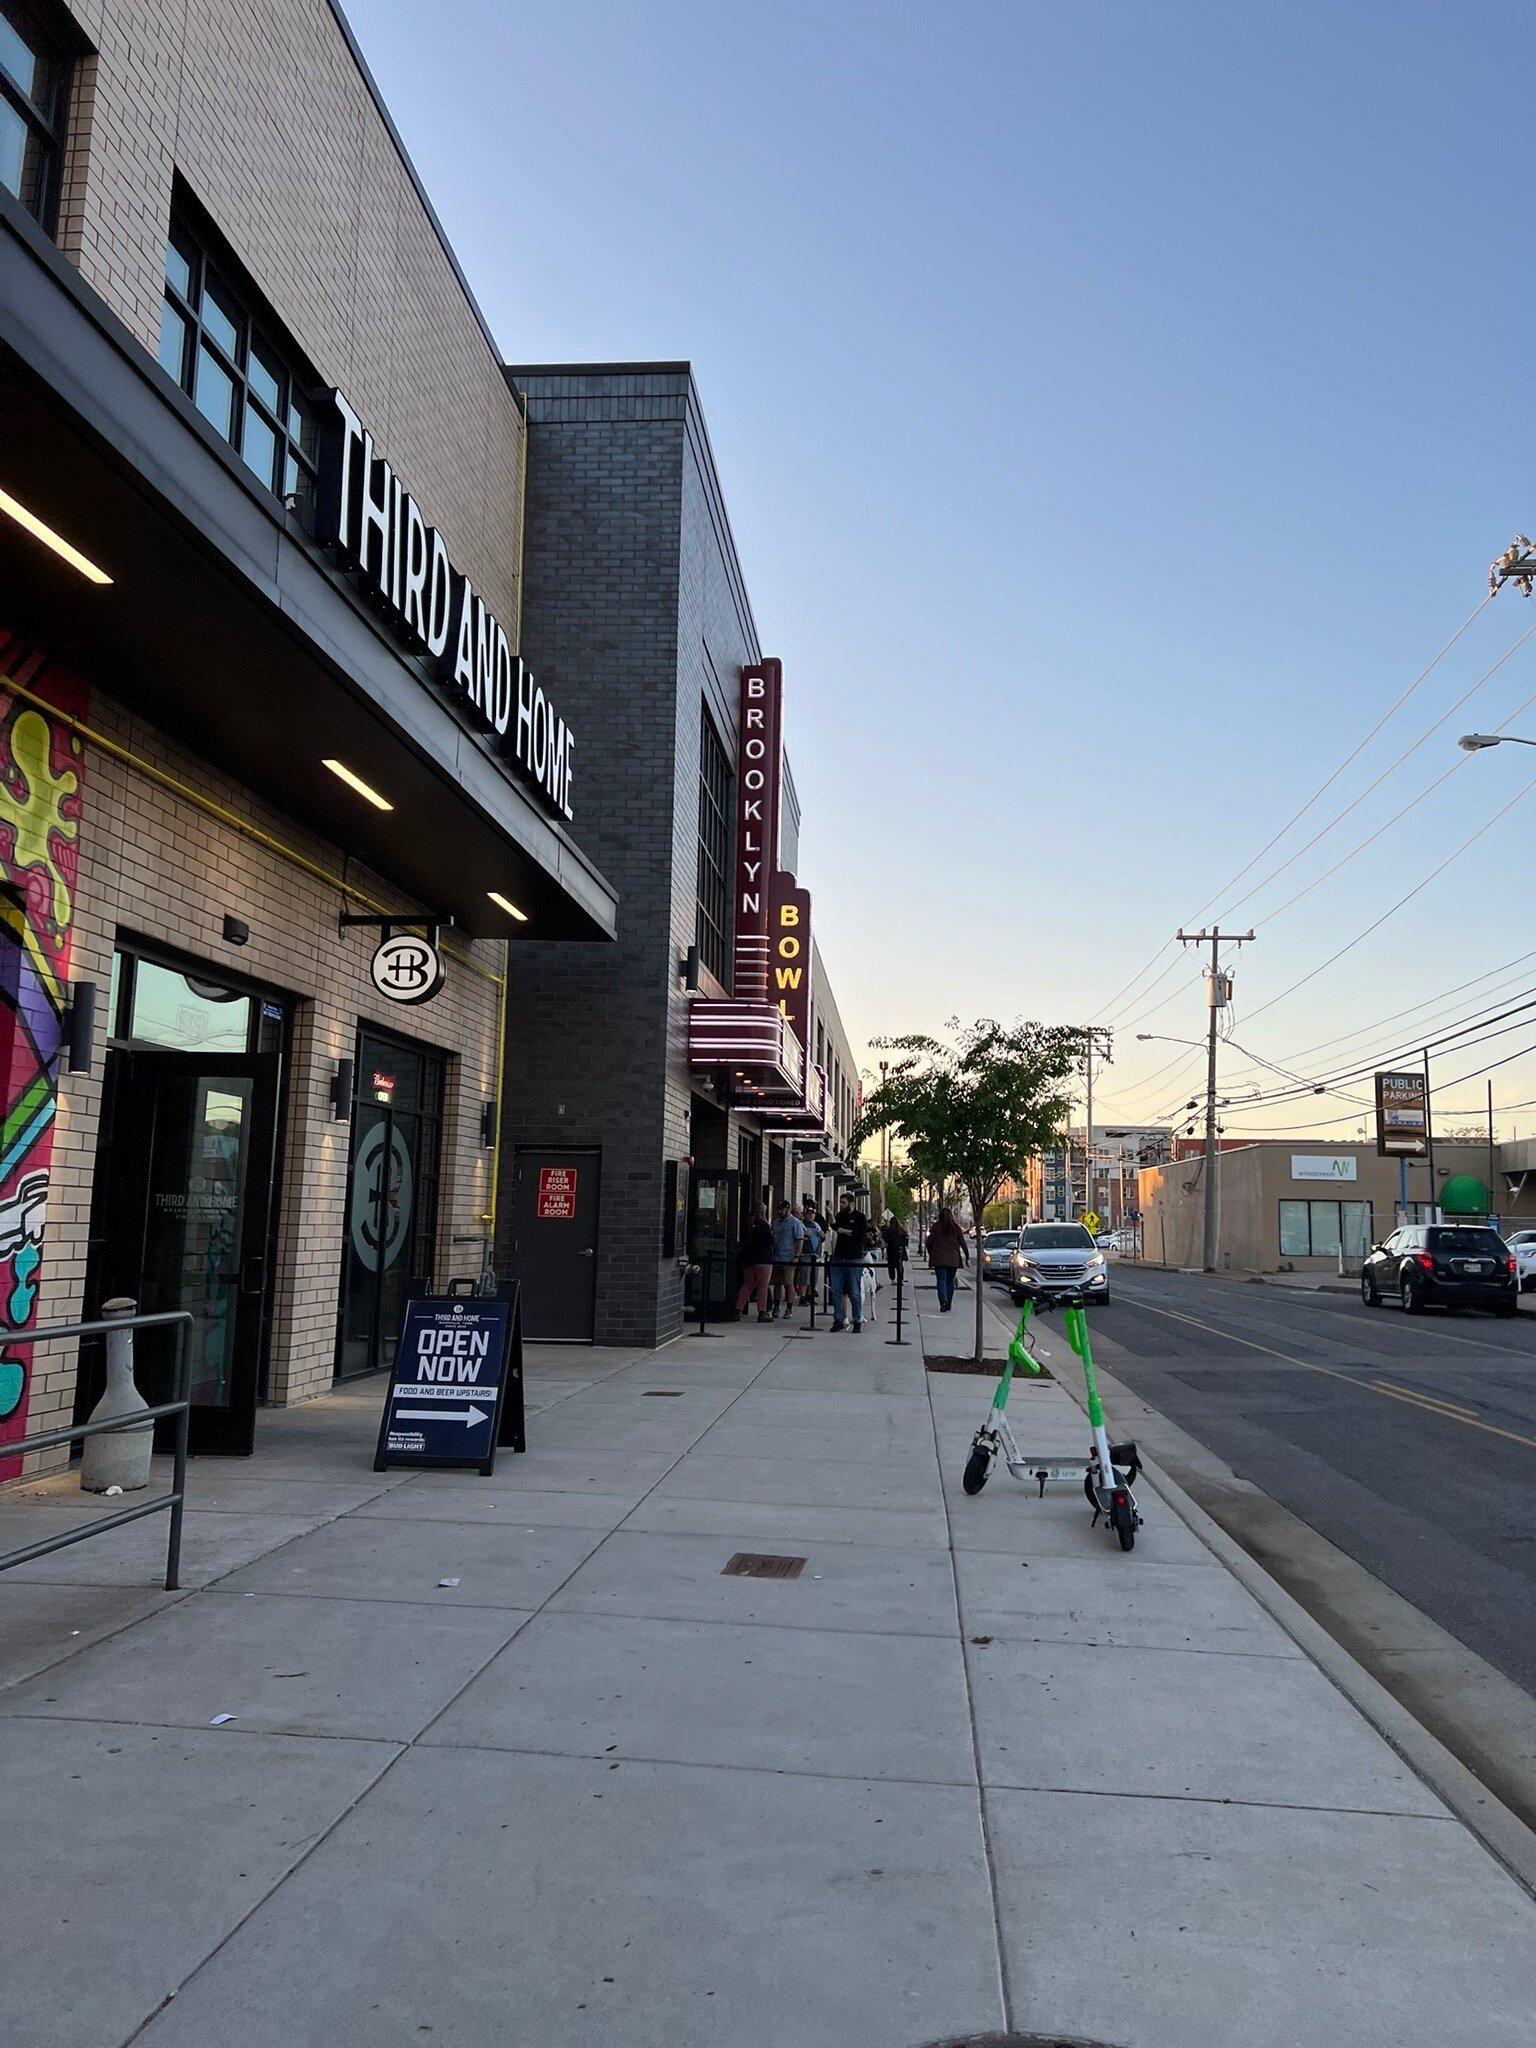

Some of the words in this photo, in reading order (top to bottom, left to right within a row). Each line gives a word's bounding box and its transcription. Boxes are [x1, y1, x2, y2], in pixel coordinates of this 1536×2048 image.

[335, 388, 450, 658] THIRD
[454, 575, 511, 735] AND
[516, 656, 575, 822] HOME
[742, 677, 766, 914] BROOKLYN
[775, 904, 802, 1021] BOWL
[1382, 1078, 1423, 1090] PUBLIC
[1382, 1091, 1424, 1101] PARKING
[155, 1193, 184, 1207] THIRD
[417, 1329, 490, 1356] OPEN
[417, 1356, 483, 1383] NOW
[399, 1387, 418, 1395] FOOD
[419, 1388, 434, 1396] AND
[436, 1388, 454, 1396] BEER
[456, 1389, 492, 1398] UPSTAIRS!
